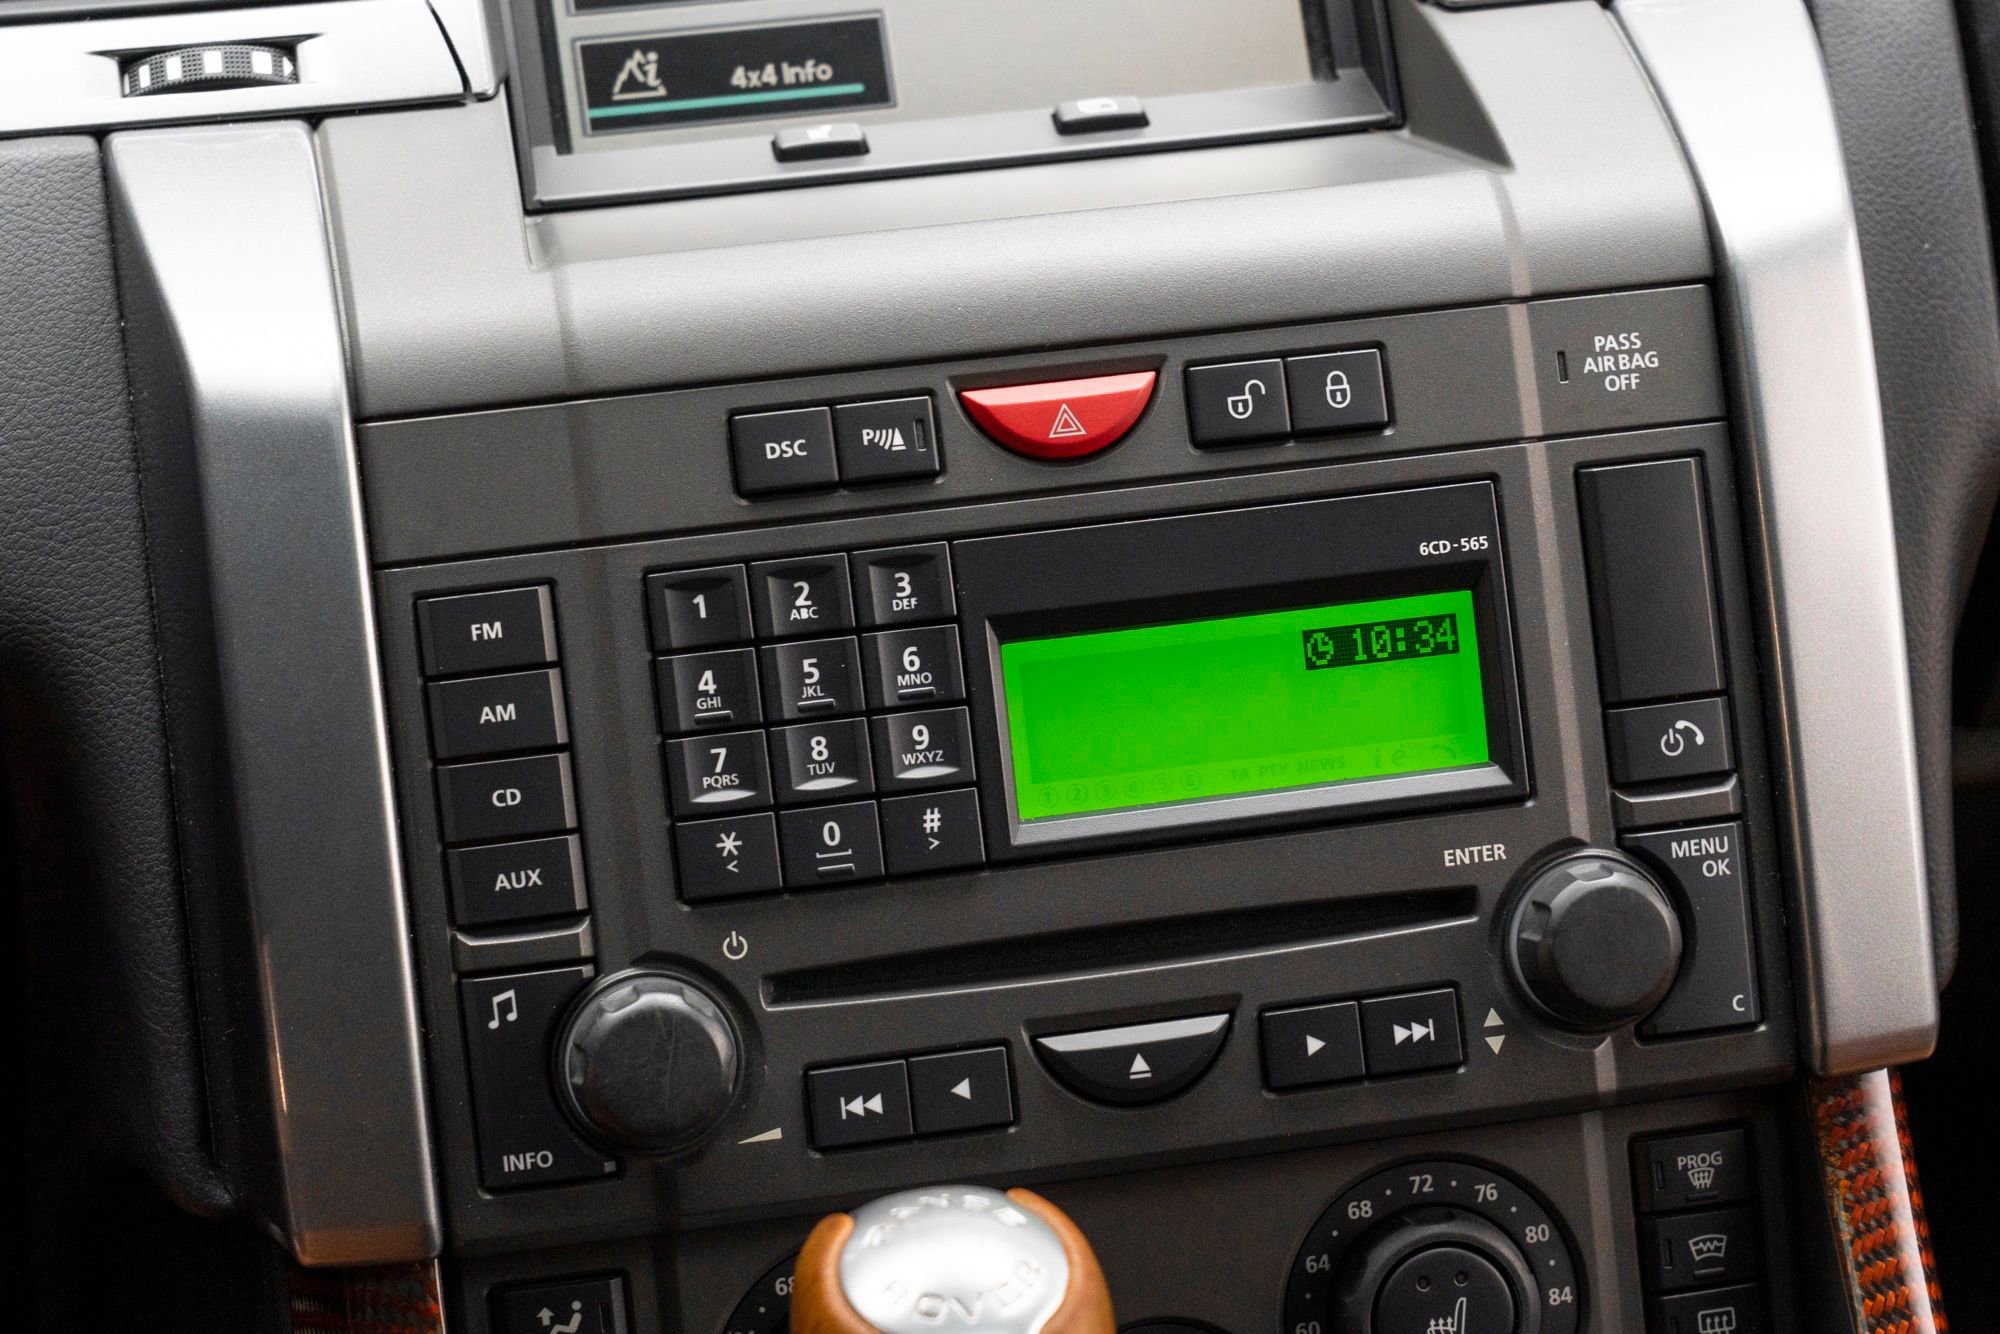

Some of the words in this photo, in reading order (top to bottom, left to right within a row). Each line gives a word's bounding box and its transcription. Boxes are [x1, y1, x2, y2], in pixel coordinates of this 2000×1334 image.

[731, 64, 777, 88] 4x4
[782, 60, 832, 84] Info
[1594, 332, 1641, 352] PASS
[1604, 373, 1640, 392] OFF
[766, 439, 807, 459] DSC
[1420, 536, 1488, 555] 6CD-565
[794, 582, 811, 606] 2
[895, 573, 911, 597] 3
[693, 595, 706, 618] 1
[892, 597, 918, 611] DEF
[790, 608, 818, 621] ABC
[471, 622, 502, 641] FM
[1353, 617, 1456, 661] 10:34
[903, 647, 920, 671] 6
[803, 659, 819, 683] 5
[897, 673, 932, 686] MNO
[698, 670, 716, 694] 4
[801, 684, 825, 698] JKL
[697, 697, 722, 710] GHI
[480, 704, 515, 723] AM
[912, 725, 929, 750] 9
[811, 736, 828, 760] 8
[711, 748, 726, 773] 7
[902, 751, 943, 765] WXYZ
[807, 762, 835, 775] TUV
[703, 774, 739, 788] PQRS
[493, 789, 521, 806] CD
[923, 808, 941, 833] #
[823, 822, 840, 846] 0
[1444, 844, 1506, 866] ENTER
[1671, 836, 1729, 858] MENU
[1703, 859, 1731, 877] OK
[495, 869, 542, 890] AUX
[1733, 995, 1744, 1011] C
[503, 1151, 552, 1172] INFO
[1678, 1151, 1722, 1169] PROG
[1409, 1175, 1433, 1193] 72
[1475, 1183, 1497, 1202] 76
[1348, 1200, 1372, 1219] 68
[1526, 1224, 1549, 1243] 80
[1306, 1254, 1329, 1272] 64
[1549, 1287, 1572, 1305] 84
